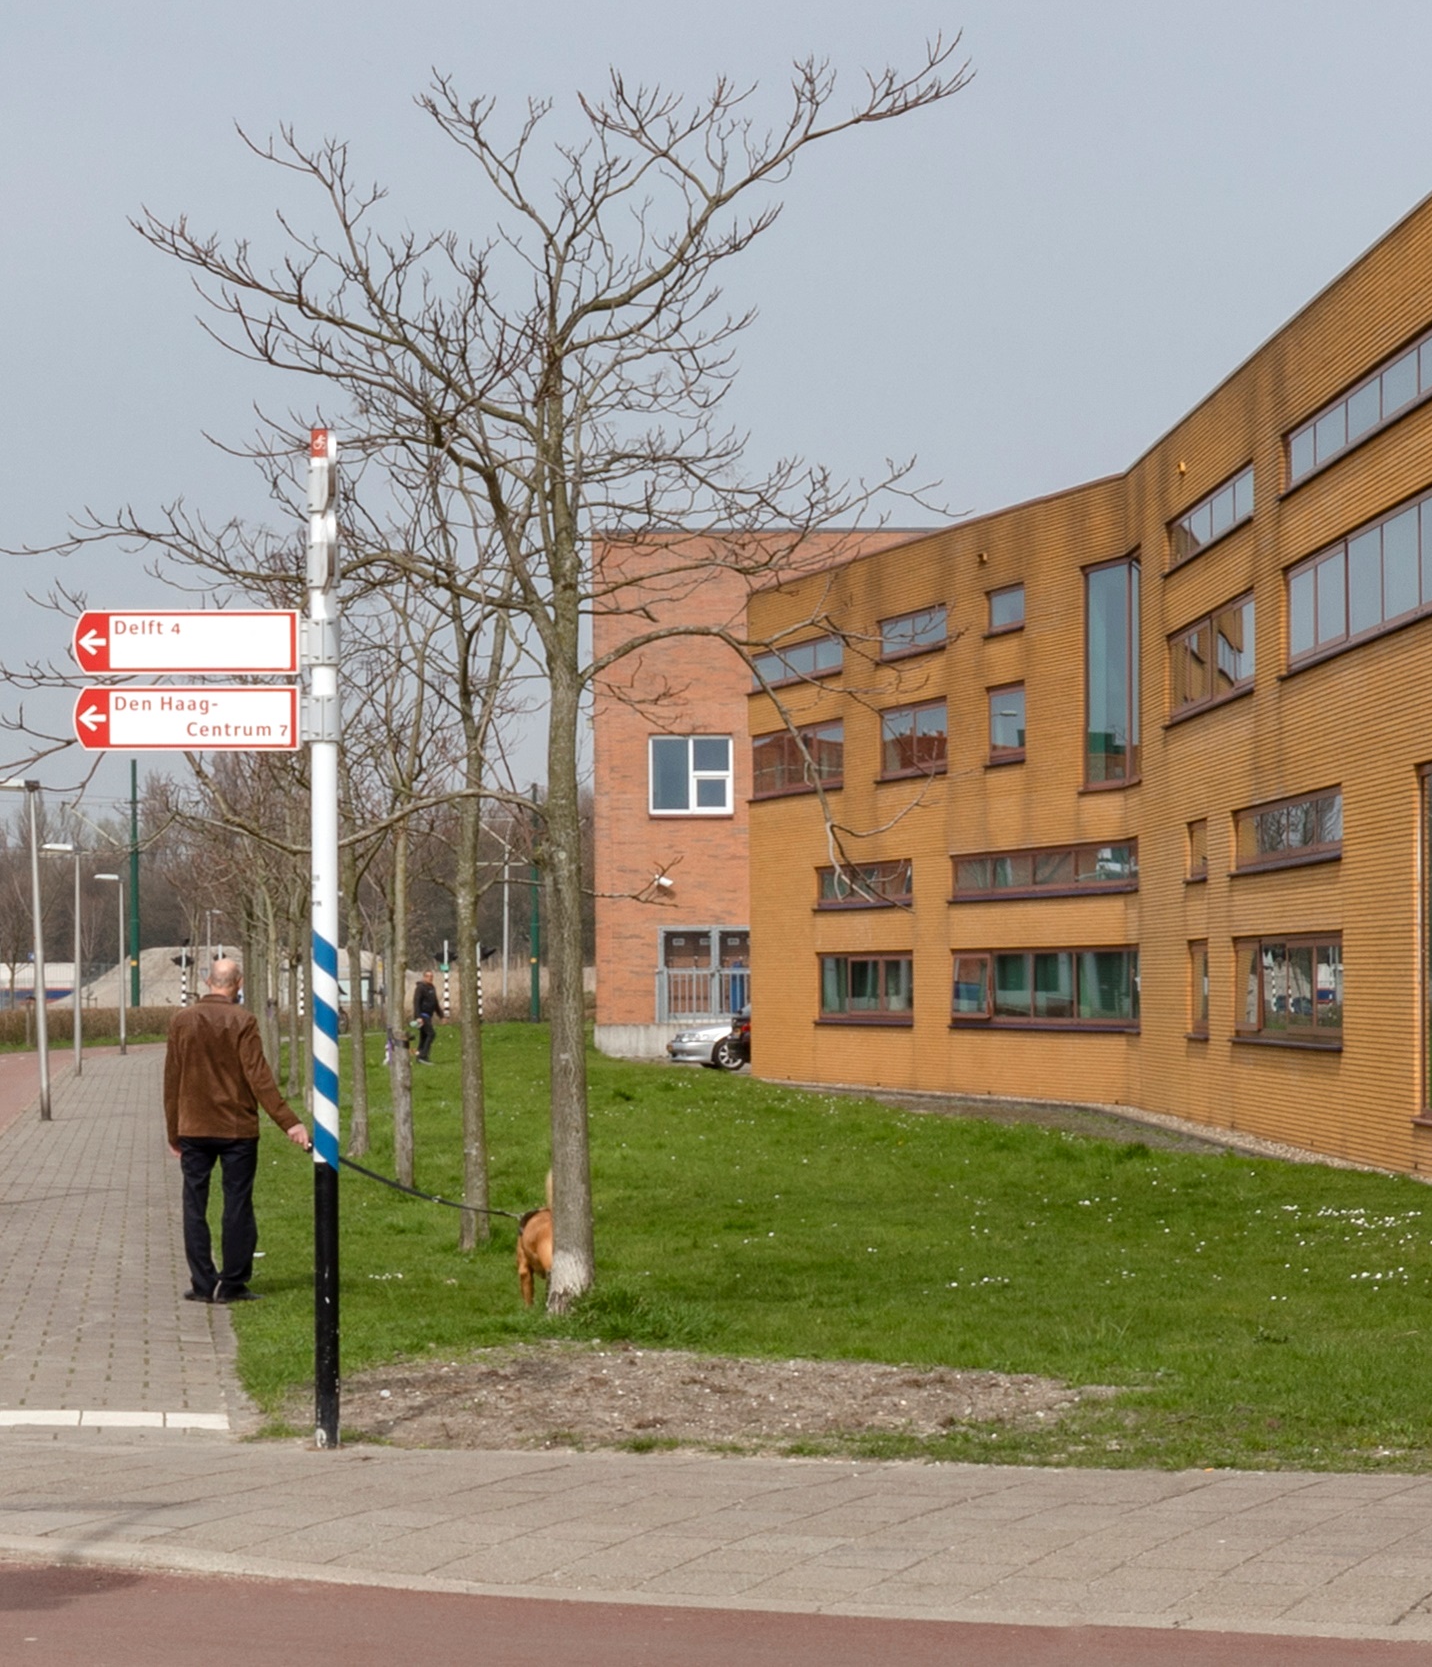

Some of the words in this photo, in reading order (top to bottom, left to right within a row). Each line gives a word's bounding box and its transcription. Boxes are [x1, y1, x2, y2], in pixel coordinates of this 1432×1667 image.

[114, 620, 163, 635] Delft
[171, 623, 181, 635] 4
[114, 696, 152, 711] Den
[160, 696, 218, 715] Haag-
[186, 721, 272, 737] Centrum
[279, 724, 288, 736] 7
